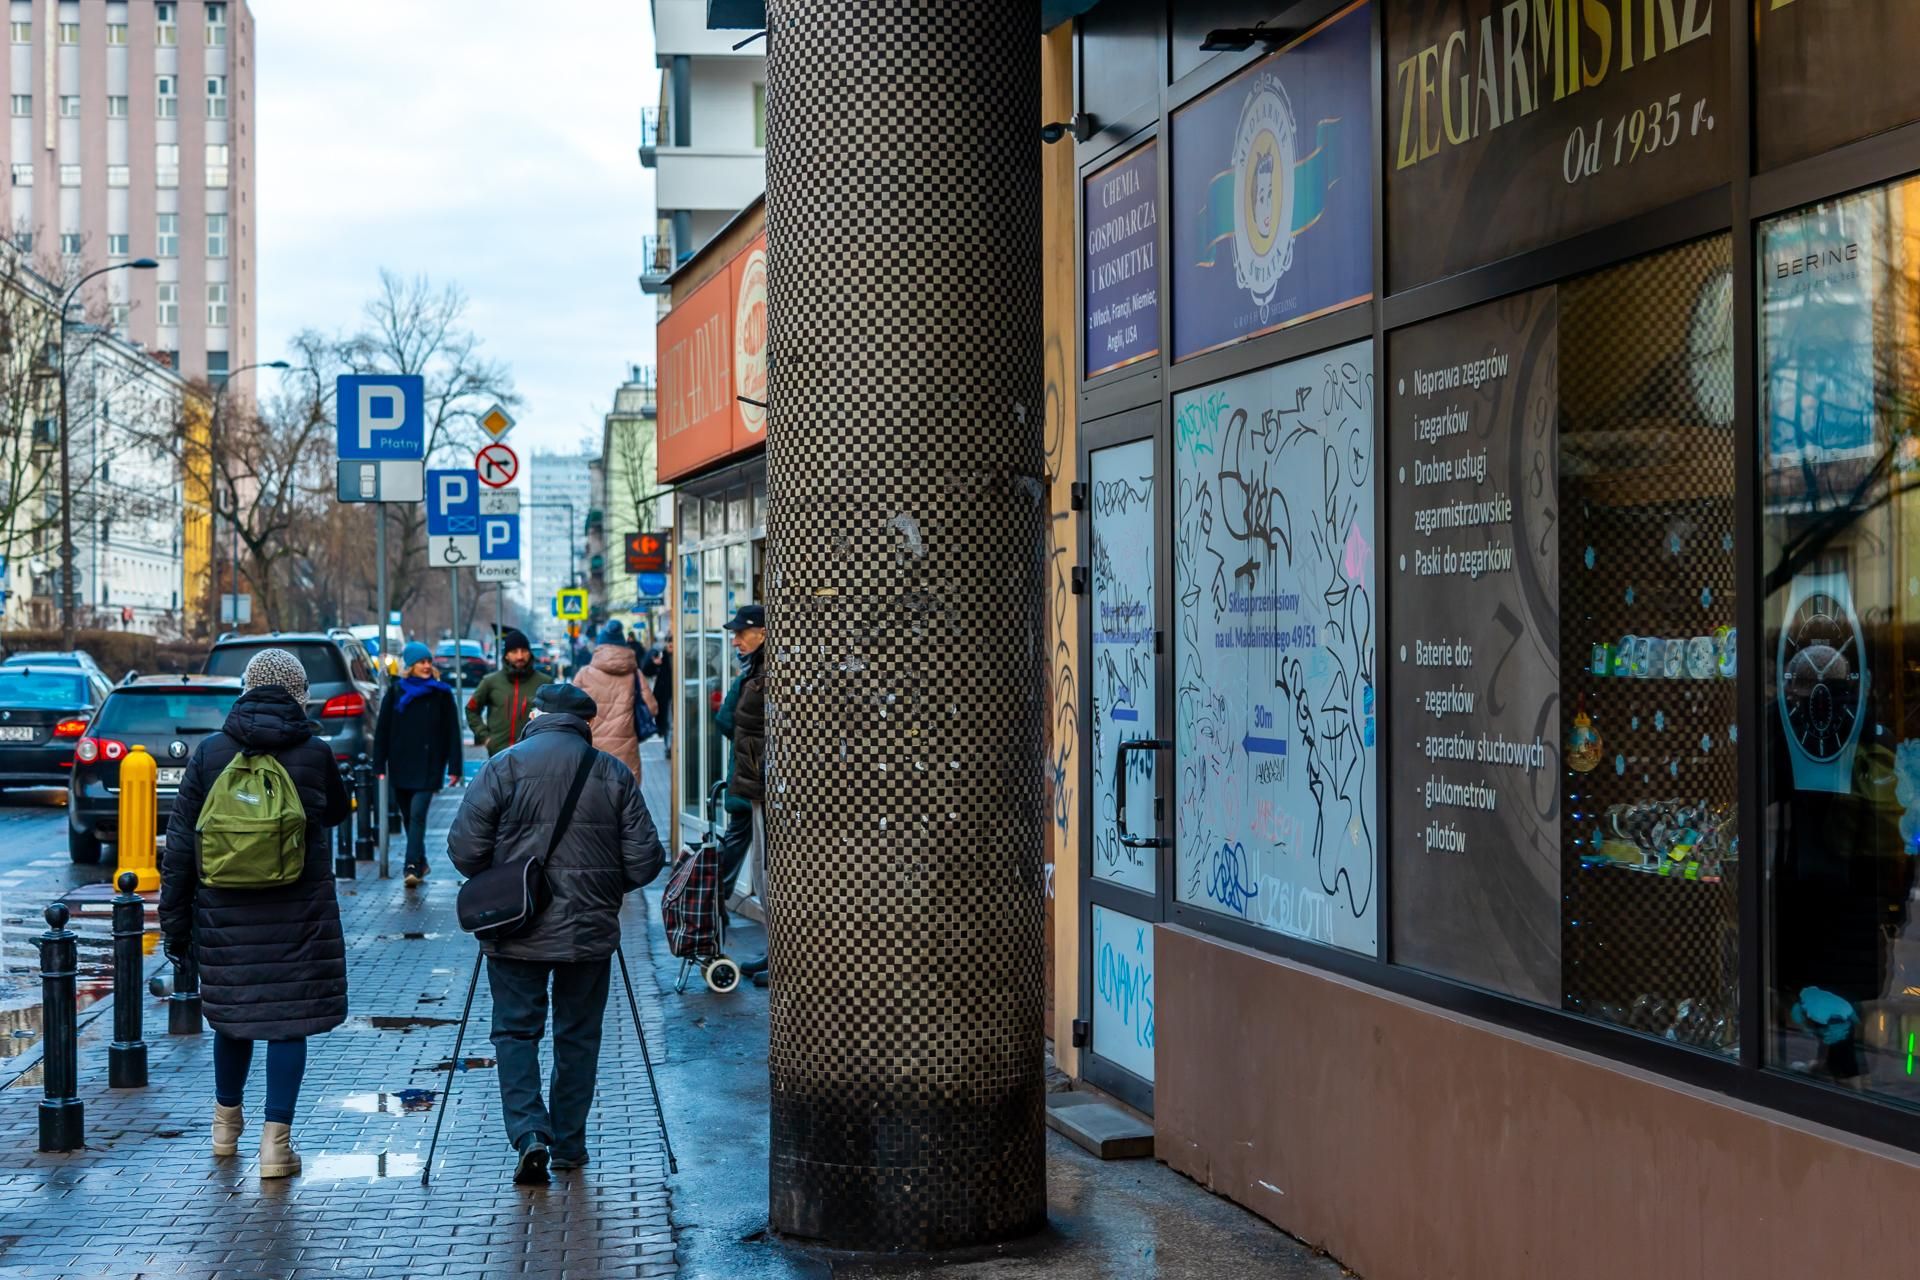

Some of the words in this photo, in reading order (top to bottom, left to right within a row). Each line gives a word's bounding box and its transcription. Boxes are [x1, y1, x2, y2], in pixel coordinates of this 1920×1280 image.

[1563, 118, 1603, 184] Od
[1613, 93, 1681, 164] 1935
[1691, 98, 1714, 136] r.
[1103, 168, 1140, 209] CHEMIA
[1088, 202, 1157, 256] GOSPODARCZA
[1091, 269, 1096, 294] I
[1099, 241, 1154, 291] KOSMETYKI
[1777, 243, 1857, 279] BERING
[1125, 324, 1138, 344] USA
[1414, 369, 1460, 399] Naprawa
[1462, 348, 1509, 390] zegarów
[358, 385, 406, 449] P
[1414, 414, 1418, 441] i
[1420, 404, 1469, 445] zegarków
[380, 437, 420, 451] Płatny
[1415, 455, 1452, 486] Drobne
[1455, 447, 1487, 484] usługi
[439, 475, 469, 516] P
[1415, 492, 1512, 537] zegarmistrzowskie
[486, 520, 511, 554] P
[479, 564, 518, 576] Koniec
[1415, 546, 1441, 576] Paski
[1443, 544, 1456, 571] do
[1459, 542, 1512, 579] zegarków
[1229, 592, 1249, 616] Sklep
[1215, 632, 1224, 648] na
[1225, 627, 1234, 648] ul.
[1292, 625, 1316, 648] 49/51
[1416, 638, 1452, 666] Baterie
[1455, 637, 1472, 666] do:
[1254, 704, 1273, 729] 30m
[1425, 684, 1475, 719] zegarków
[1425, 730, 1476, 764] aparatów
[1477, 732, 1545, 773] słuchowych
[1425, 774, 1496, 810] glukometrów
[1426, 821, 1466, 853] pilotów
